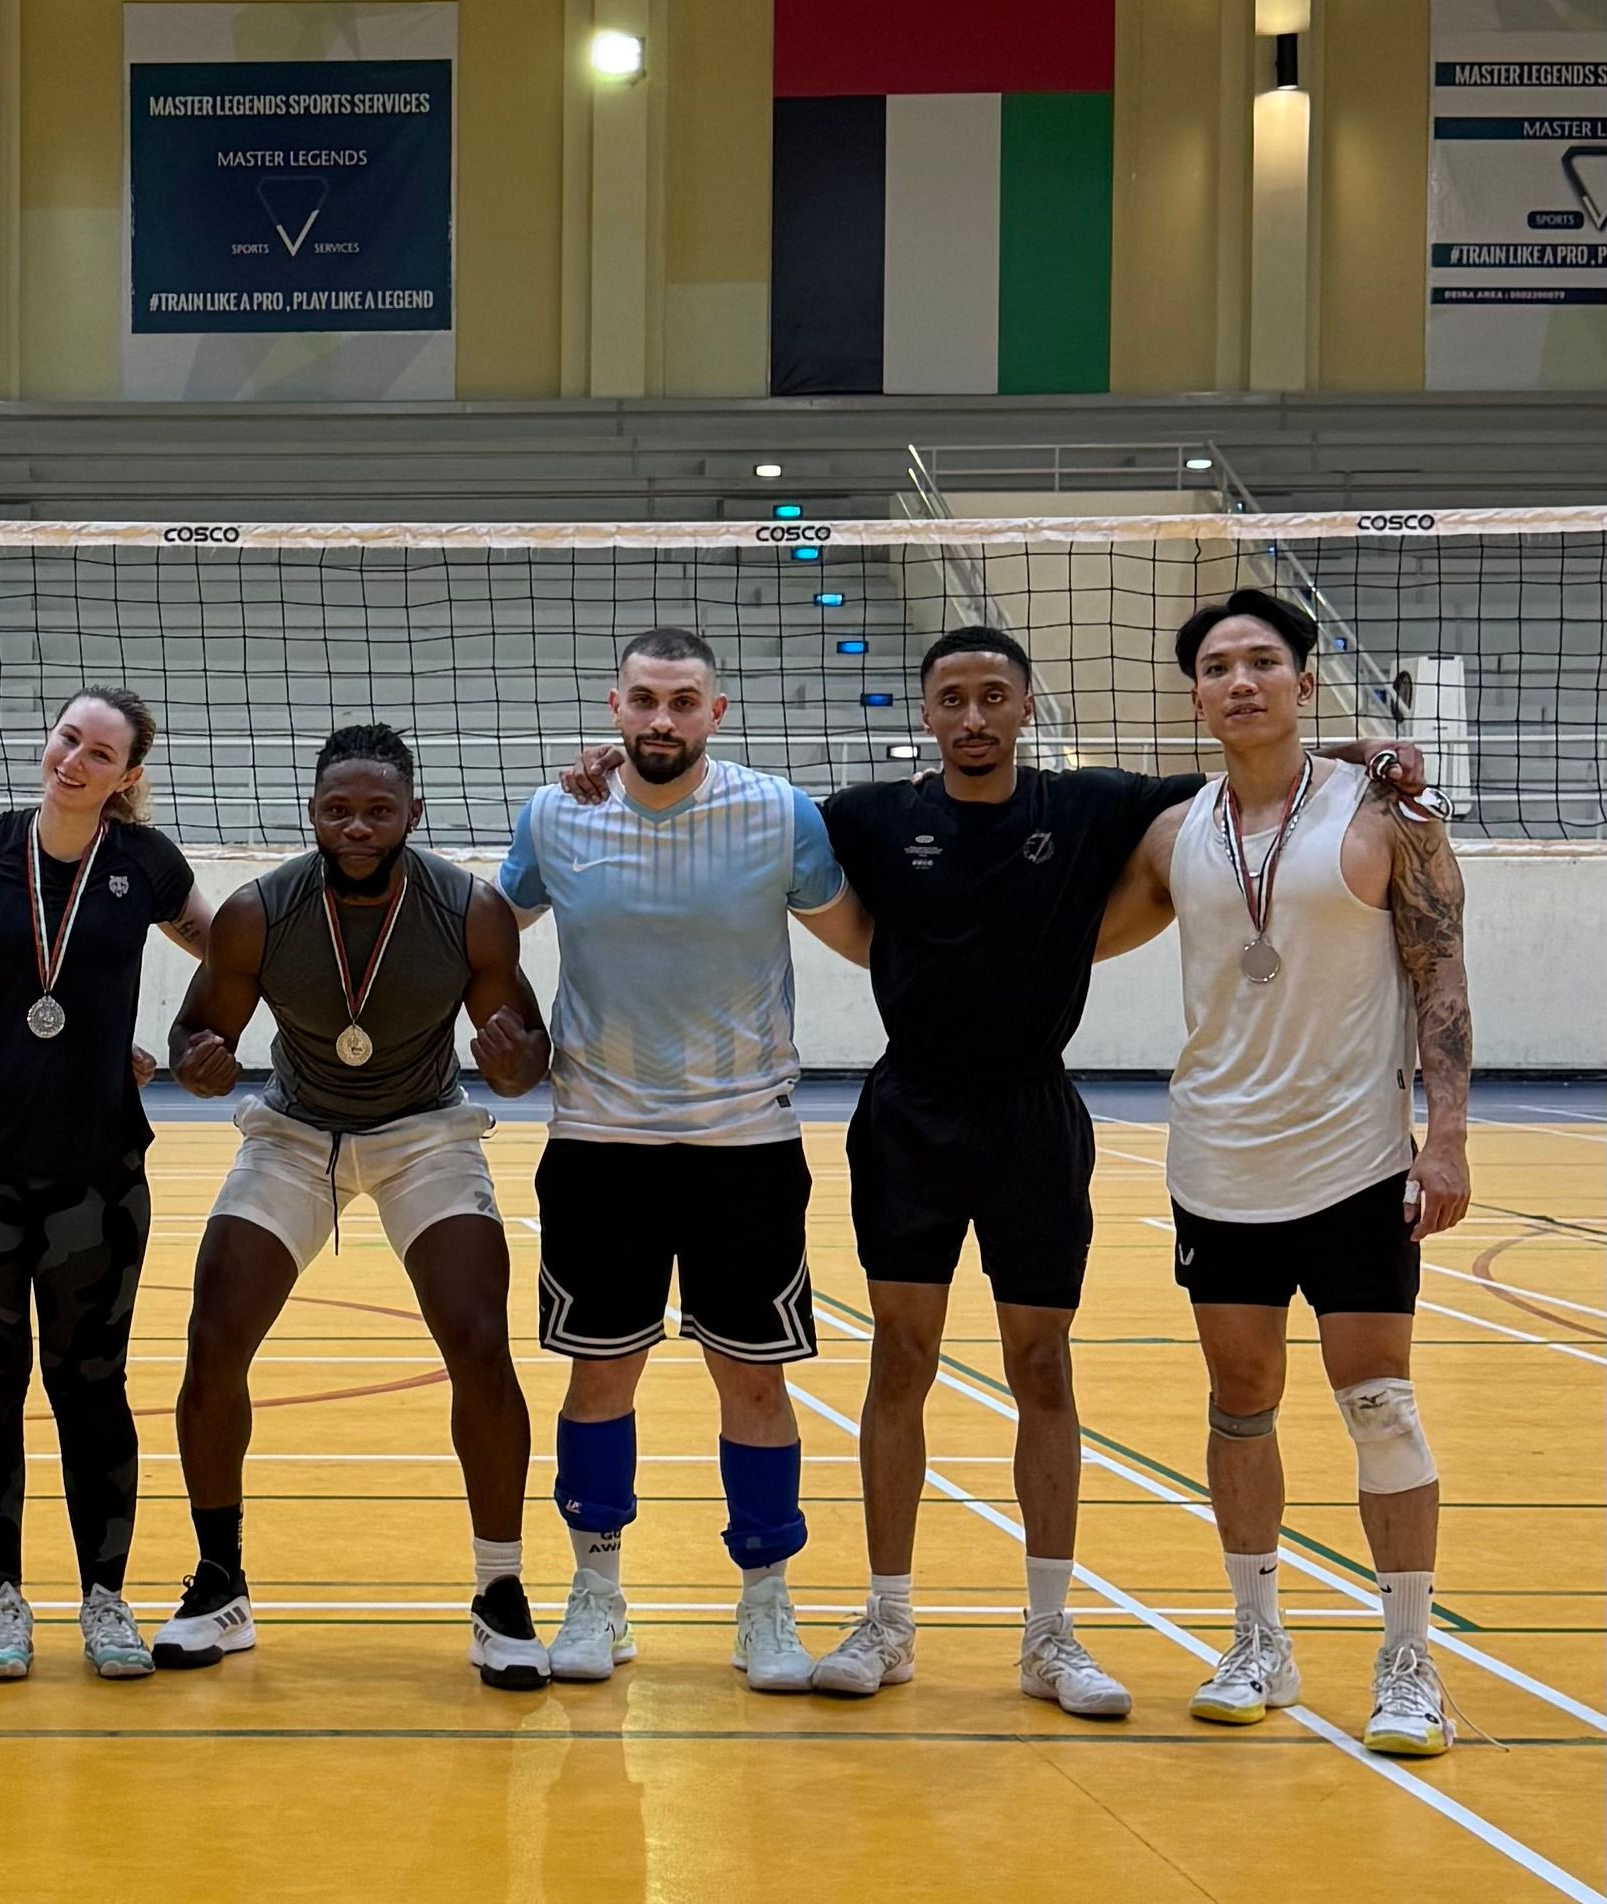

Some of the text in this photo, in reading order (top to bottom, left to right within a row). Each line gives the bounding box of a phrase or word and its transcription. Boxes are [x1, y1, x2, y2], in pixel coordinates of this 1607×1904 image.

[1455, 64, 1520, 85] MASTER
[1524, 64, 1594, 85] LEGENDS
[149, 93, 430, 117] MASTER LEGENDS SPORTS SERVICES
[1523, 121, 1592, 137] MASTER
[217, 150, 368, 167] MASTER LEGENDS
[1535, 215, 1574, 225] SPORTS
[232, 243, 360, 254] SPORTS SERVICES
[1450, 246, 1506, 264] #TRAIN
[1509, 246, 1541, 264] LIKE
[1544, 246, 1554, 264] A
[1557, 246, 1588, 264] PRO
[149, 293, 204, 312] #TRAIN
[206, 293, 238, 311] LIKE
[240, 293, 250, 311] A
[253, 292, 283, 311] PRO
[293, 292, 328, 310] PLAY
[331, 291, 362, 310] LIKE
[364, 291, 375, 309] A
[378, 290, 434, 309] LEGEND
[1357, 513, 1435, 531] COSCO
[163, 526, 240, 543] COSCO
[755, 525, 831, 542] COSCO
